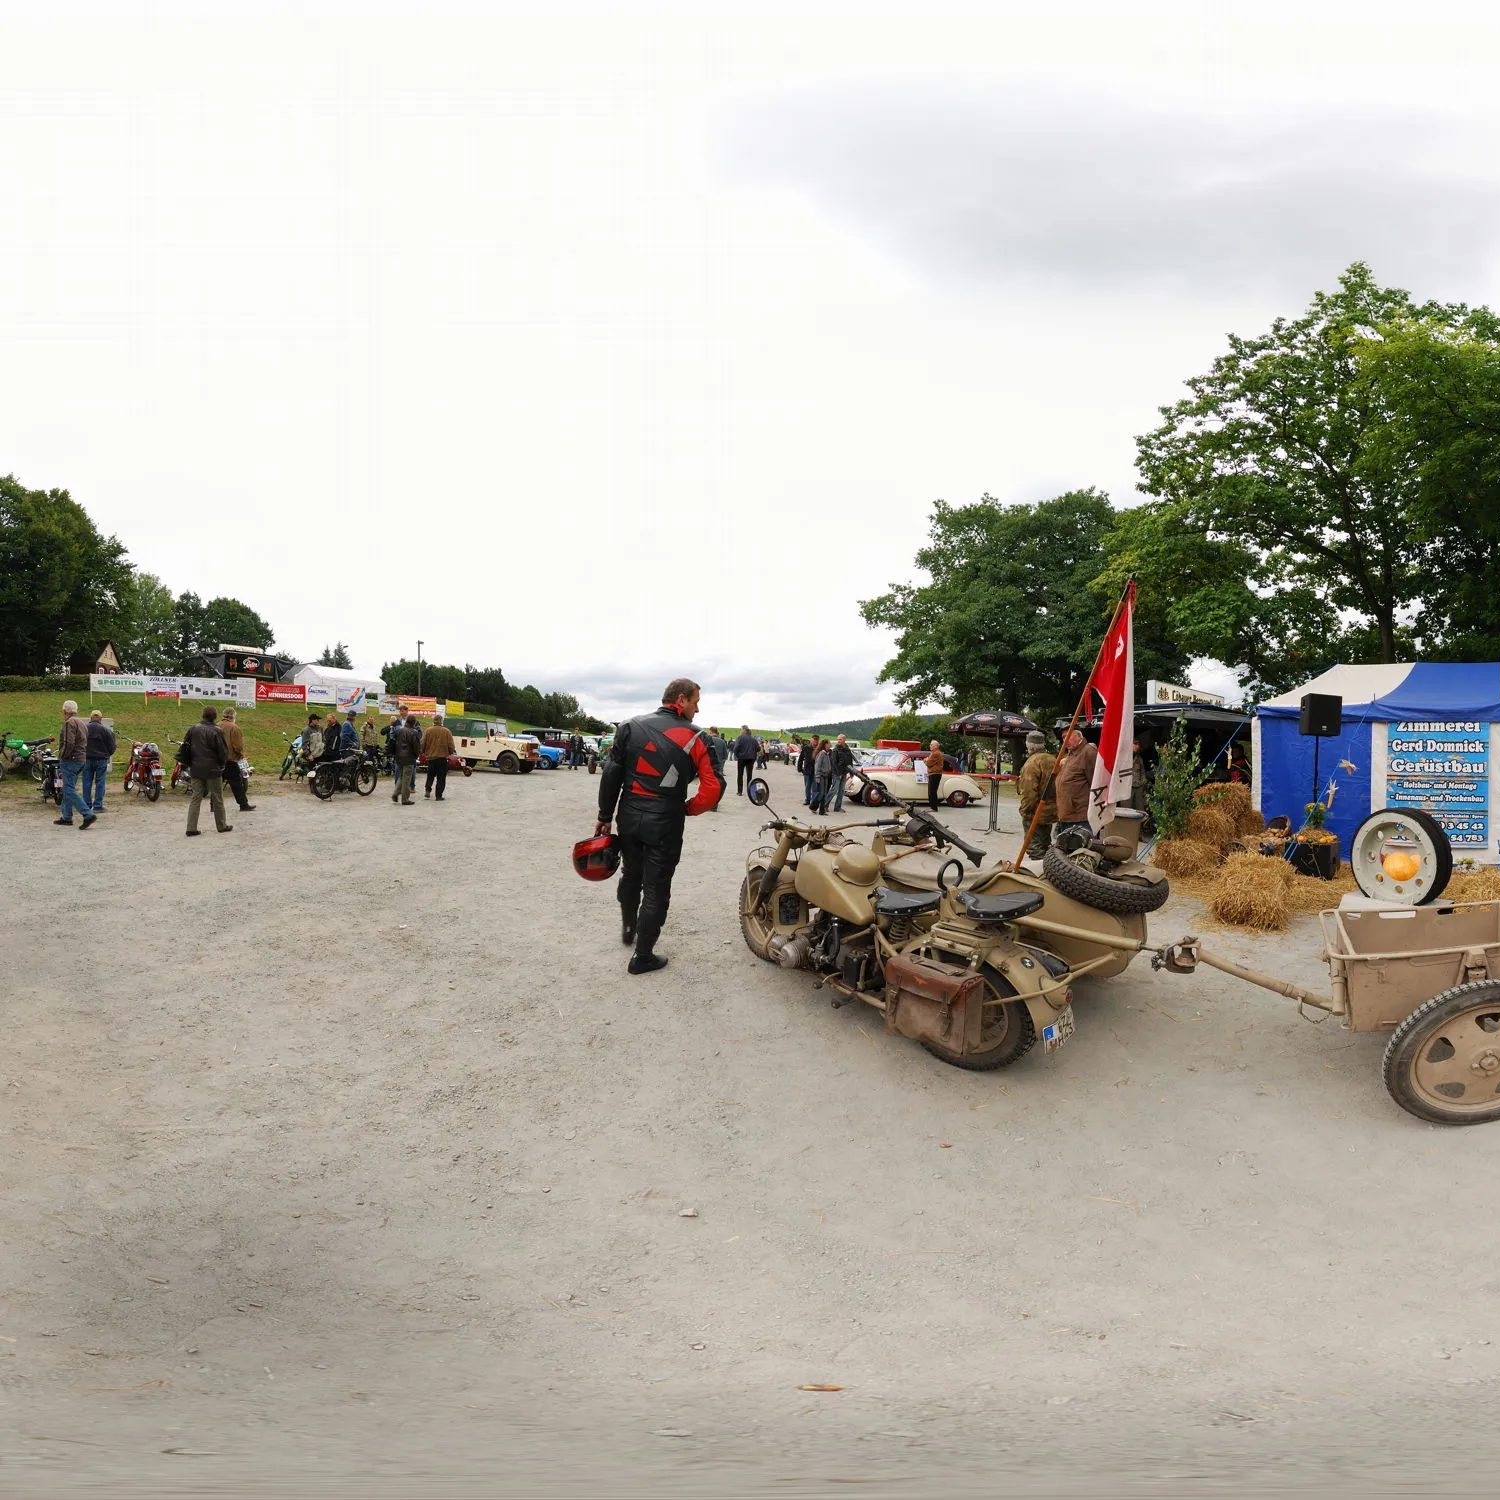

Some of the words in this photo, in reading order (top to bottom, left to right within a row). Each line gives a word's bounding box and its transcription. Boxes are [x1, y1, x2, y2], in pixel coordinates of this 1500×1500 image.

[1397, 721, 1481, 732] Zimmerei
[1391, 739, 1423, 753] Gerd
[1426, 740, 1485, 753] Domnick
[1391, 759, 1485, 773] Gerüstbau
[1434, 781, 1447, 790] und
[1448, 781, 1478, 791] Montage
[1430, 793, 1444, 802] und
[1445, 793, 1485, 803] Trockenbau
[1447, 822, 1455, 830] 3
[1456, 822, 1469, 830] 45
[1471, 822, 1484, 831] 42
[1450, 834, 1463, 842] 54
[1465, 834, 1484, 842] 783
